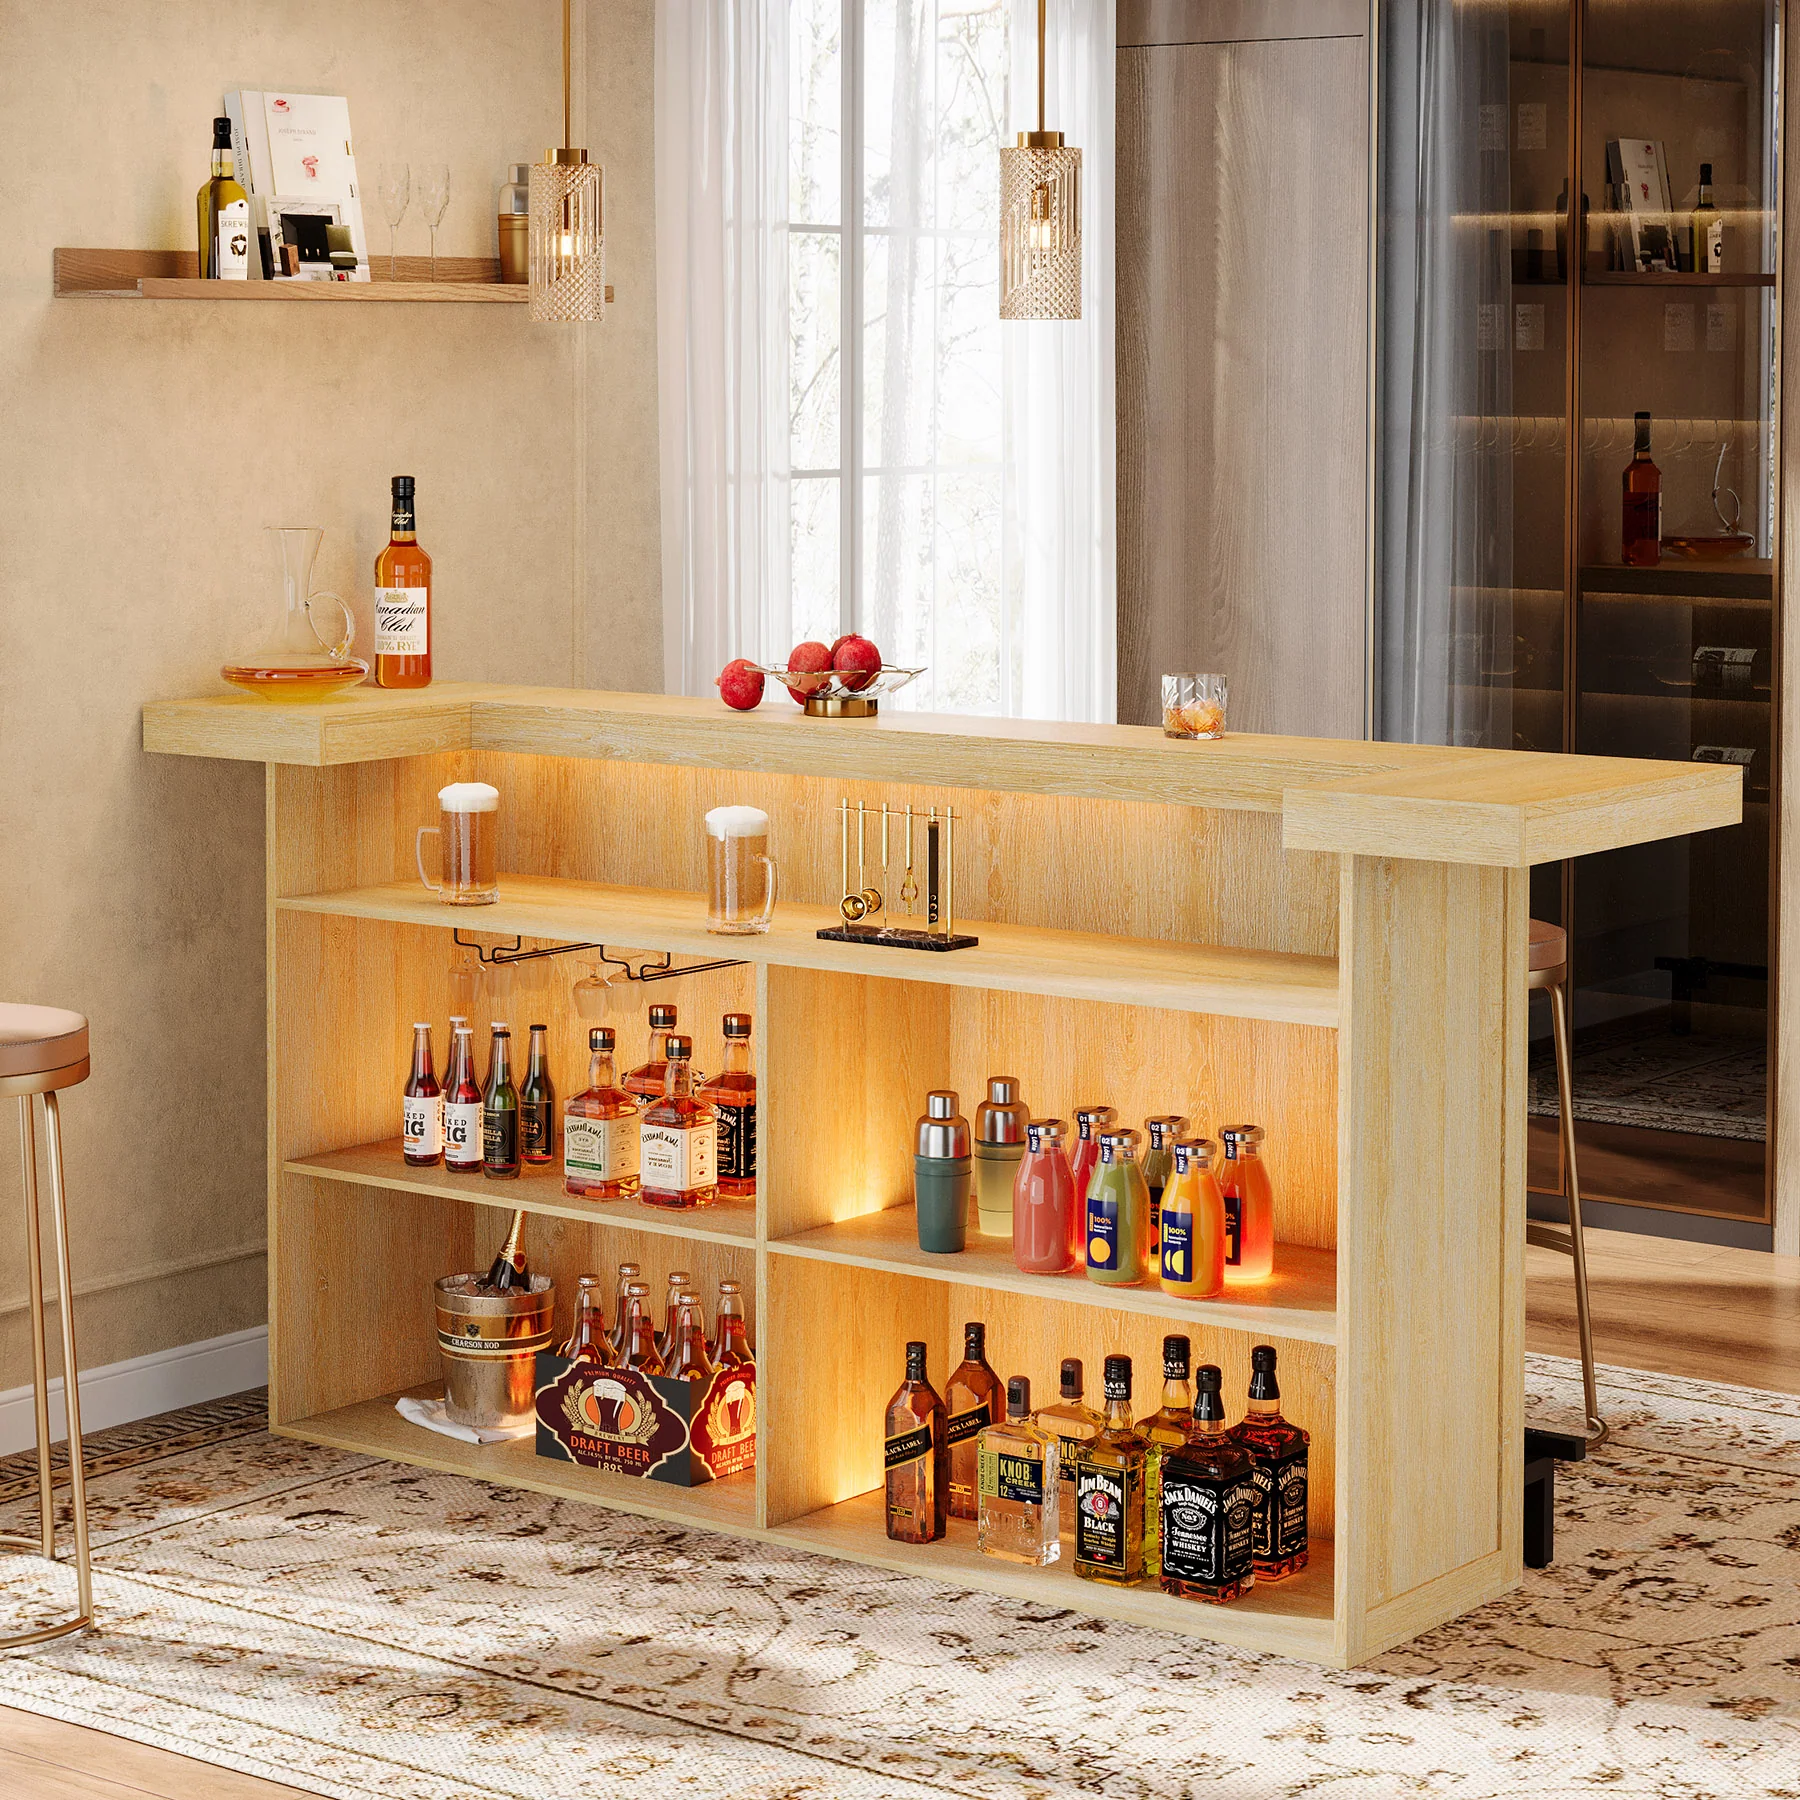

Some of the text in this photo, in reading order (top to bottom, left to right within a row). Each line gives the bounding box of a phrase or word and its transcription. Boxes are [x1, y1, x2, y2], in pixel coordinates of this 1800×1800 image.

[234, 127, 242, 156] JOSEPH
[379, 615, 417, 632] Club
[396, 641, 418, 652] RYE
[404, 1112, 425, 1120] KED
[446, 1118, 467, 1126] KED
[404, 1120, 425, 1136] IG
[446, 1126, 467, 1142] IG
[1101, 1137, 1111, 1145] 02
[1093, 1215, 1112, 1225] 100%
[1168, 1226, 1187, 1236] 100%
[451, 1338, 500, 1349] CHARSON NOD
[1163, 1360, 1184, 1368] LACK
[612, 1373, 636, 1386] QUALITY
[1104, 1380, 1126, 1388] LACK
[594, 1430, 625, 1442] BREWERY
[948, 1425, 961, 1434] ACK
[570, 1435, 651, 1463] DRAFT BEER
[712, 1439, 756, 1464] DRAFT BEE
[885, 1445, 902, 1456] LACK
[1060, 1441, 1077, 1459] NO
[598, 1460, 623, 1474] 1895
[1060, 1457, 1077, 1466] CRE
[1000, 1458, 1030, 1481] KNOB
[1005, 1476, 1037, 1489] CREEK
[1278, 1471, 1291, 1491] JACK
[999, 1485, 1008, 1497] 12
[1077, 1474, 1122, 1505] JIM BEAM
[1164, 1486, 1219, 1517] JACK DANIEL'S
[1222, 1492, 1237, 1514] JACK
[1083, 1516, 1116, 1534] BLACK
[1171, 1526, 1208, 1542] Tennessee
[1172, 1540, 1208, 1553] WHISKEY
[1228, 1538, 1250, 1552] WHISKEY
